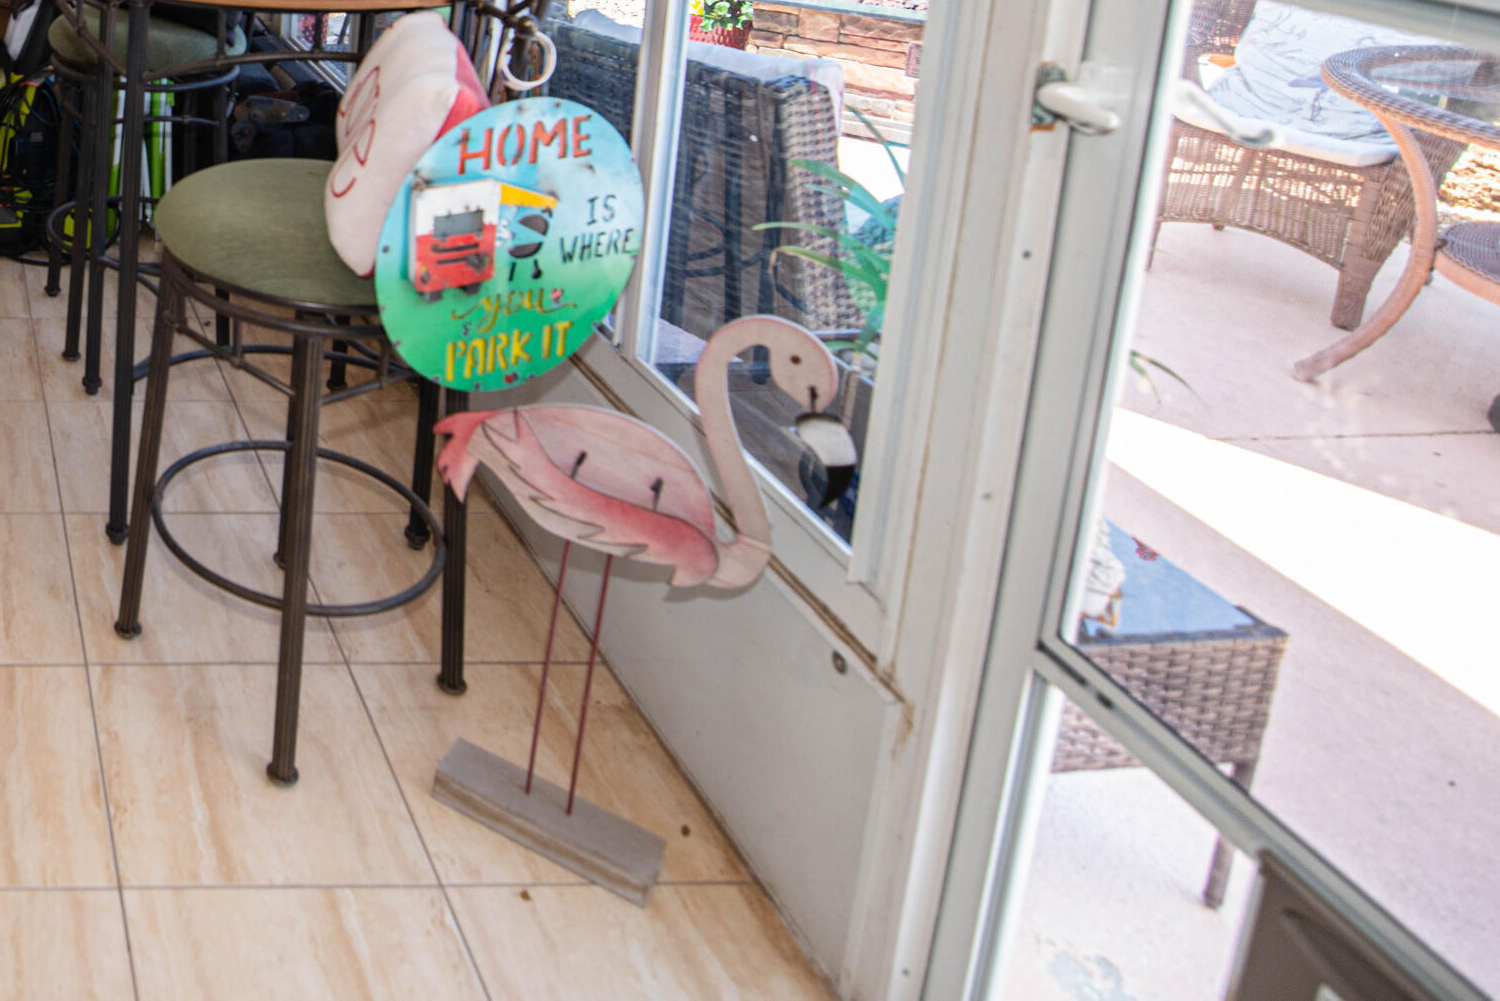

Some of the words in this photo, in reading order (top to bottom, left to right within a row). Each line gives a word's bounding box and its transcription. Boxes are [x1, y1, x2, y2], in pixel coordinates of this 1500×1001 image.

[457, 113, 593, 176] HOME
[587, 193, 617, 226] IS
[560, 227, 635, 264] WHERE
[446, 329, 534, 382] PARK
[542, 320, 574, 360] IT
